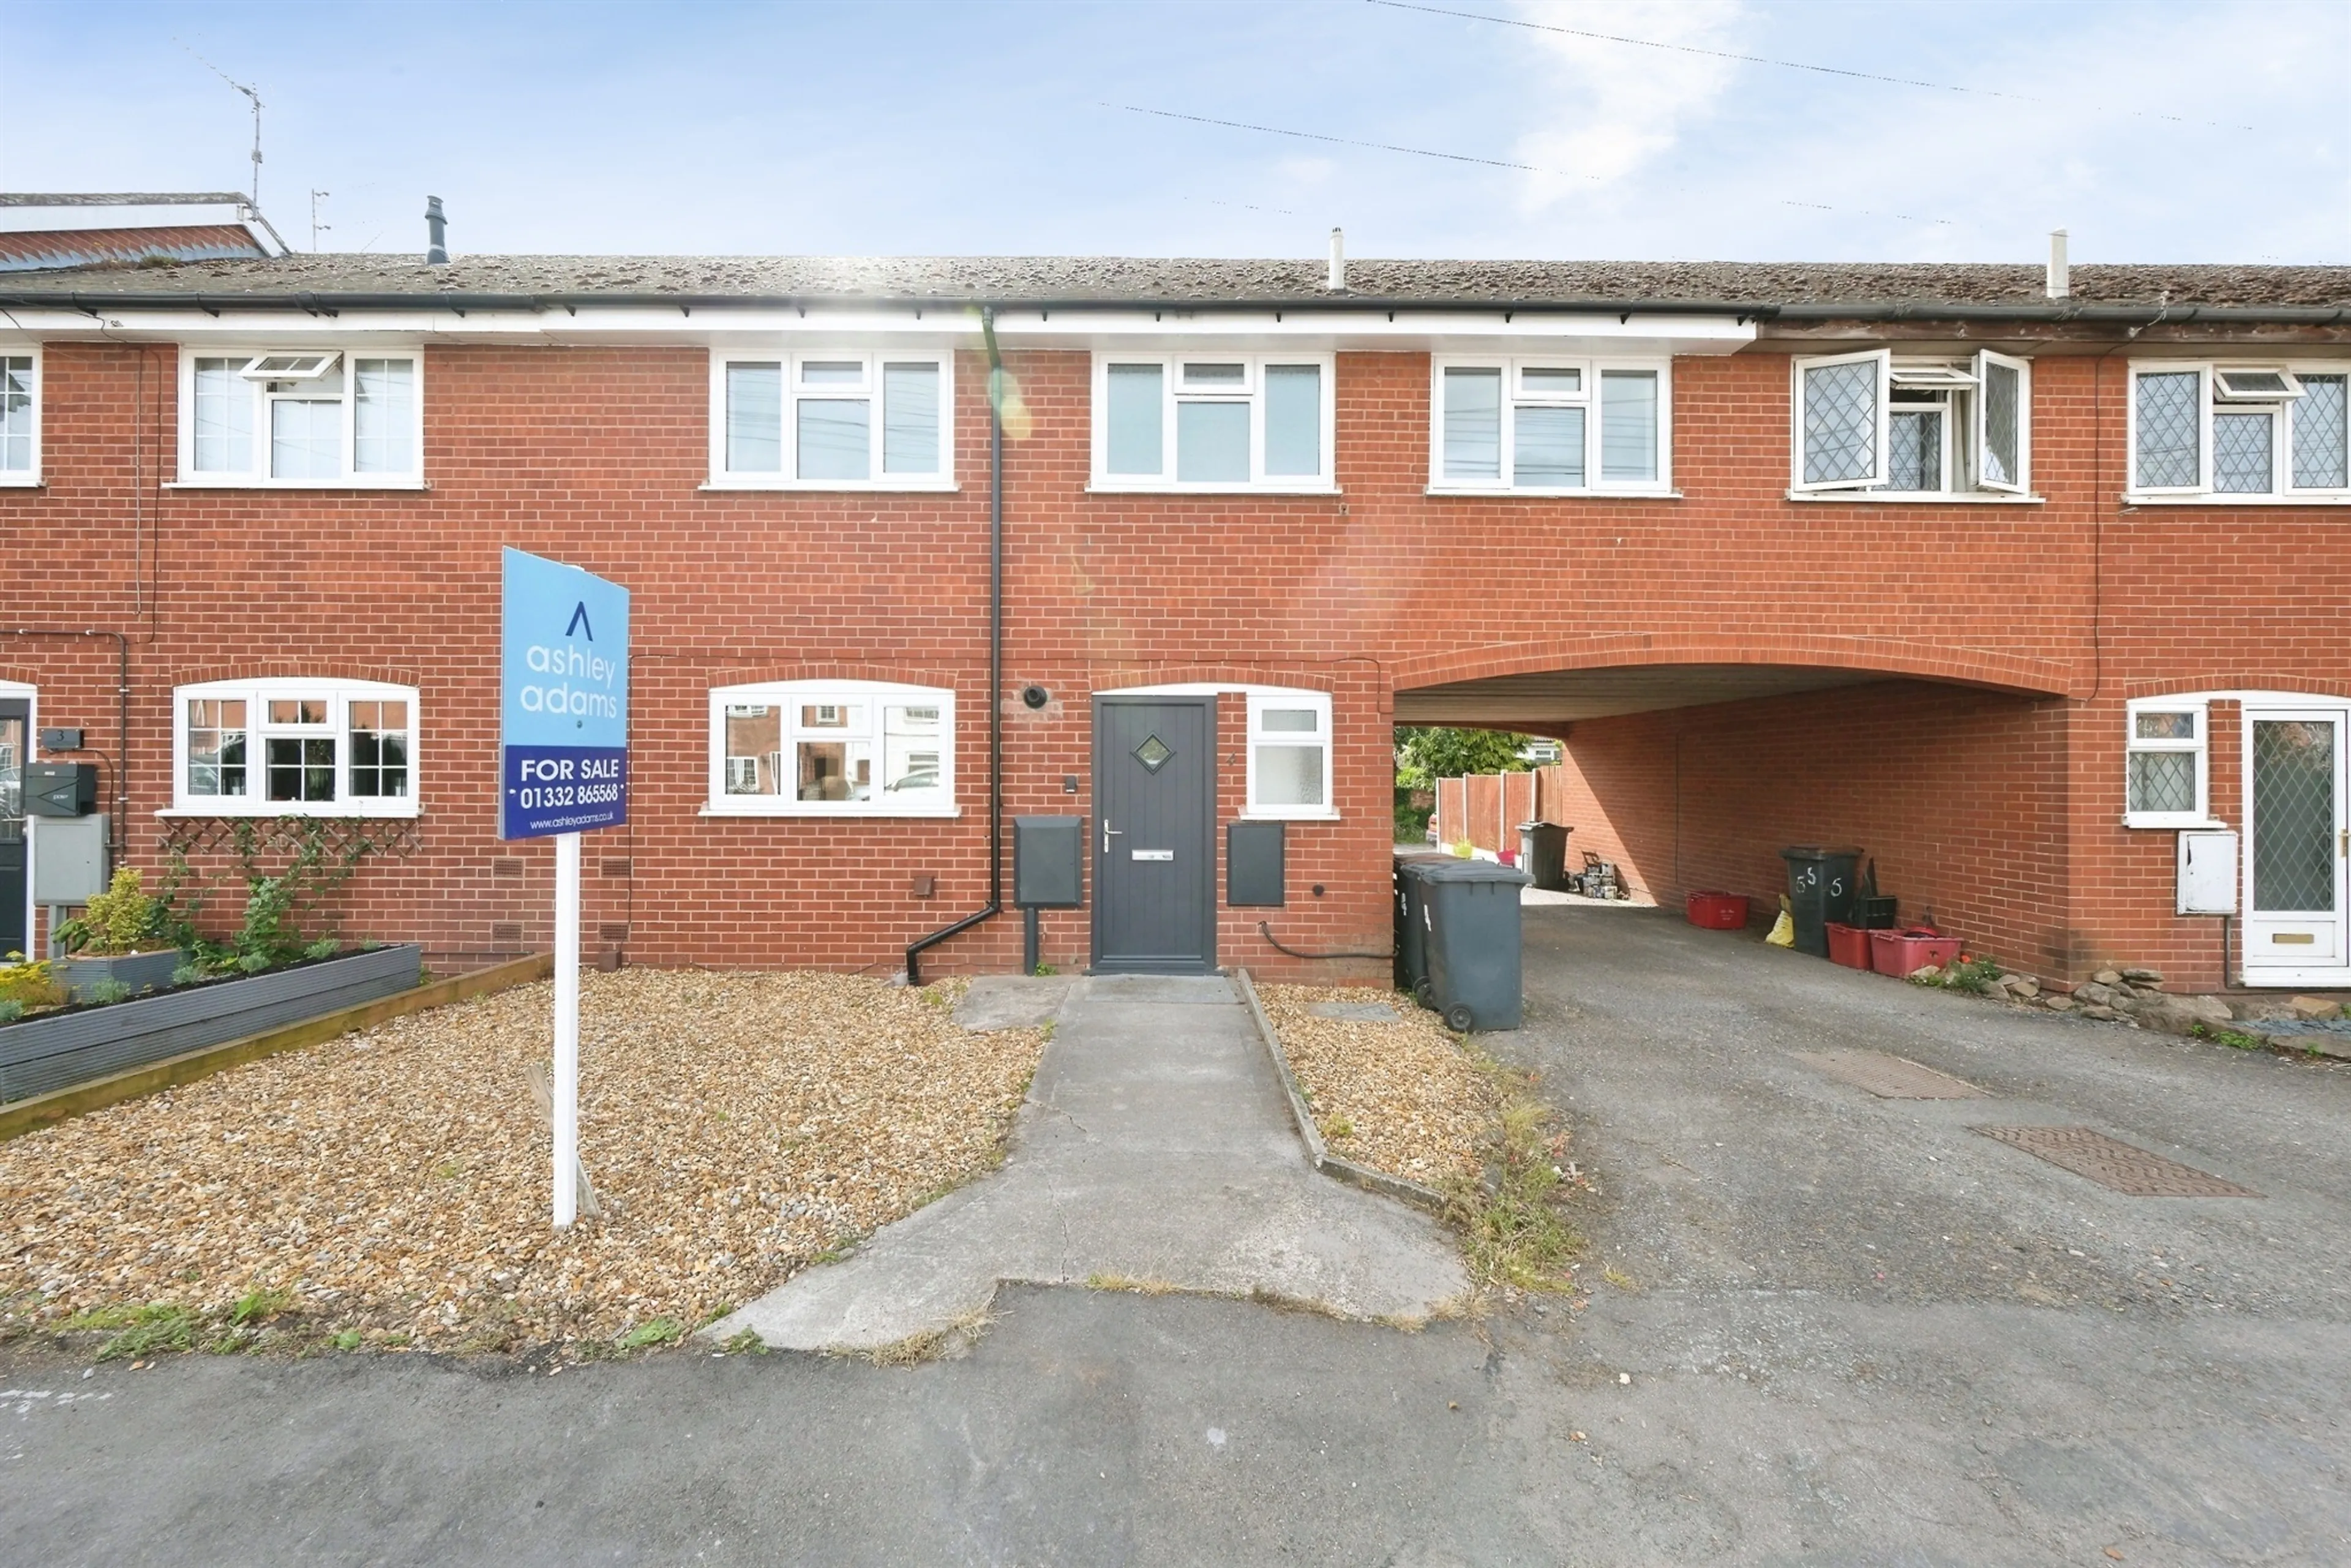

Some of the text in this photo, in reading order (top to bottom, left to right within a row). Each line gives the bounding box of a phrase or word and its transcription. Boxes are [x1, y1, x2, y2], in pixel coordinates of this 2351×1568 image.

[527, 644, 616, 689] ashley
[520, 682, 617, 719] adams
[56, 730, 65, 741] 3
[521, 759, 619, 781] FOR SALE
[521, 782, 618, 809] 01332 865568
[530, 811, 614, 830] www.ashleyadams.co.uk
[1830, 877, 1843, 898] 5
